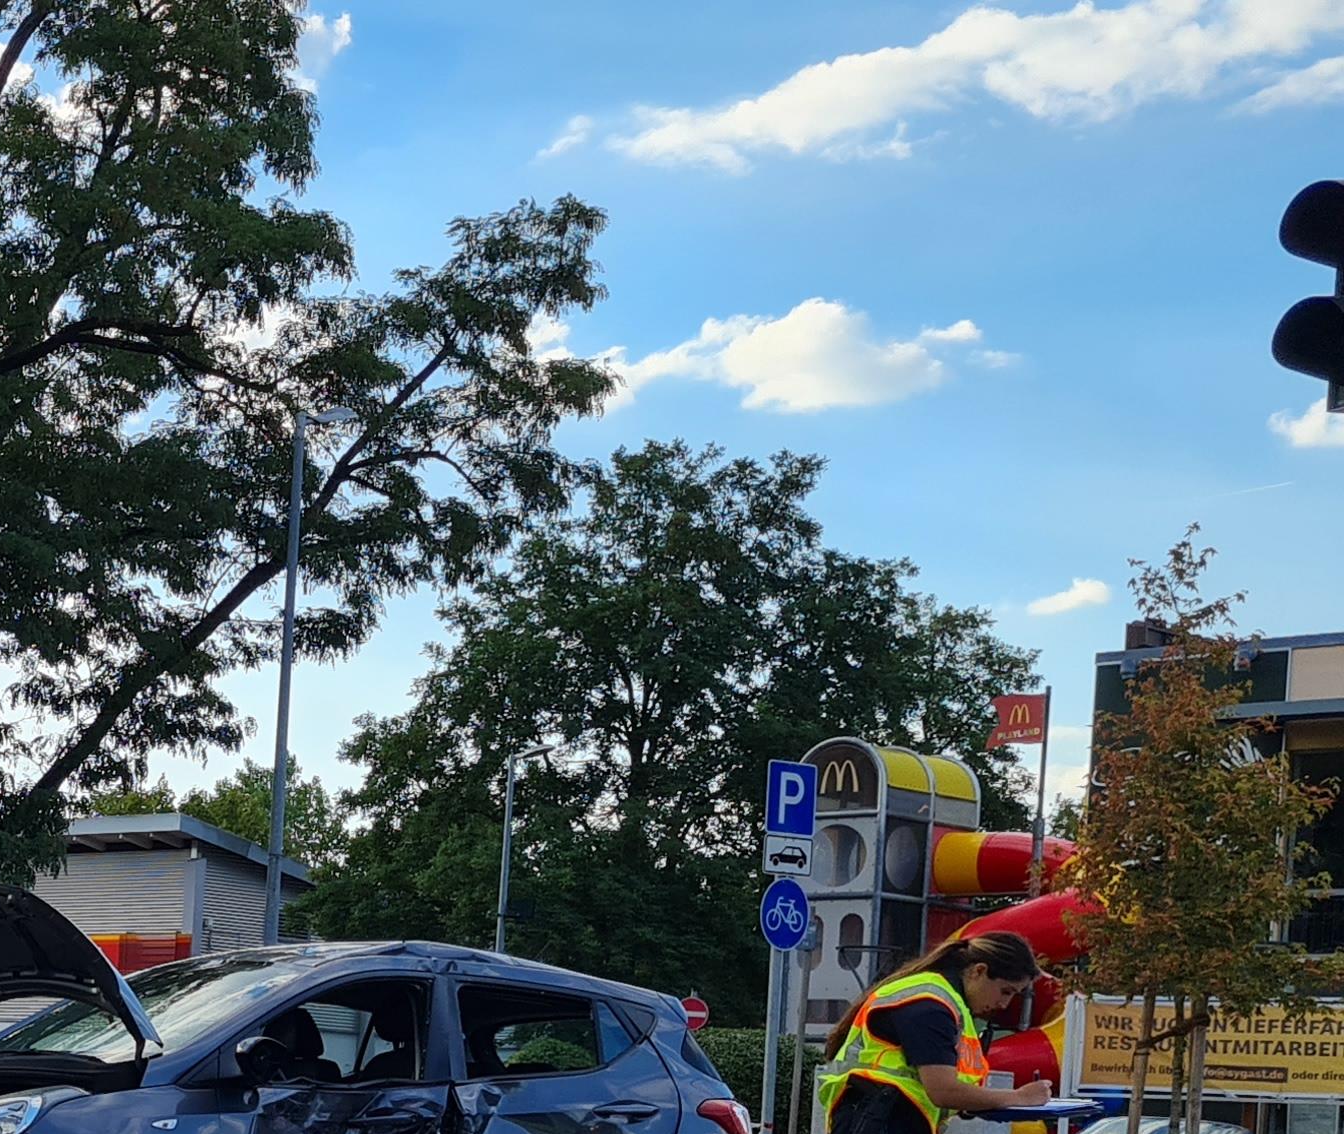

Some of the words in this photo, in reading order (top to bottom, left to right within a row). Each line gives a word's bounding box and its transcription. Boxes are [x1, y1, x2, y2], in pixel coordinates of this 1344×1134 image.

[997, 728, 1040, 740] PLAYLAND
[1094, 1015, 1133, 1031] WIR
[1203, 1066, 1285, 1080] fo@sygast.de
[1291, 1070, 1320, 1081] oder
